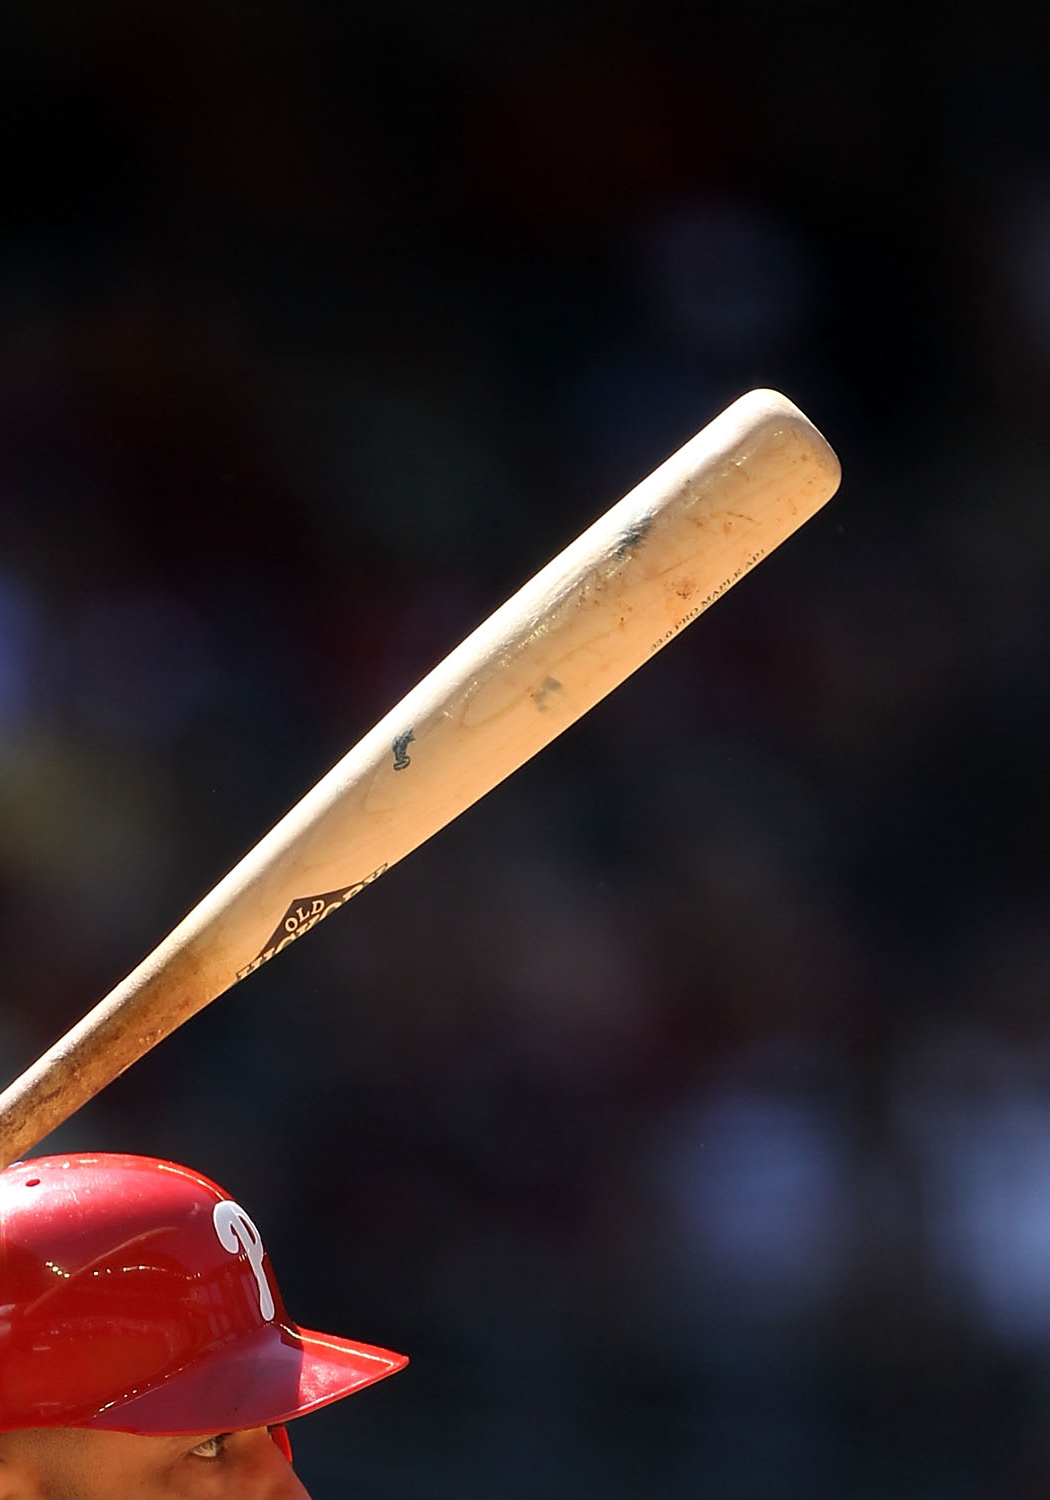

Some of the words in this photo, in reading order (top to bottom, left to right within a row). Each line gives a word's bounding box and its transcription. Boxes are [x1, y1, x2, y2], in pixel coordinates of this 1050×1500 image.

[675, 606, 700, 631] PRO
[701, 568, 743, 608] MAPLE
[284, 899, 325, 932] OLD
[212, 1200, 275, 1321] P
